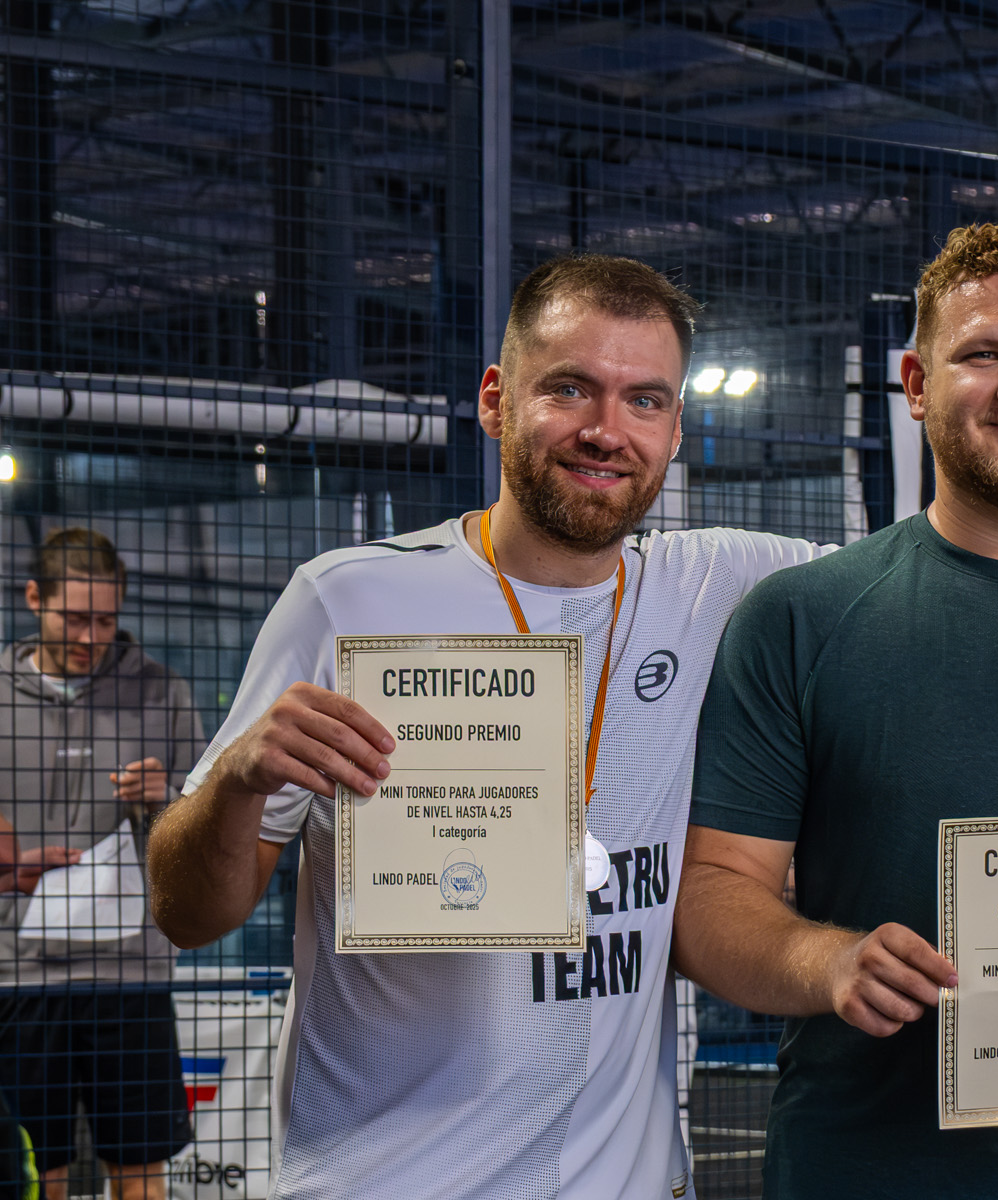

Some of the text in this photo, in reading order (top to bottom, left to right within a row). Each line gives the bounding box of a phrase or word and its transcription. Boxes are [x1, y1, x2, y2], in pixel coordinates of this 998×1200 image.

[382, 668, 535, 698] CERTIFICADO
[397, 724, 521, 742] SEGUNDO PREMIO
[380, 785, 539, 799] MINI TORNEO PARA JUGADORES
[407, 805, 420, 818] DE
[423, 805, 453, 818] NIVEL
[455, 805, 488, 818] HASTA
[432, 824, 487, 842] I categoría
[372, 872, 404, 886] LINDO
[406, 872, 439, 886] PADEL
